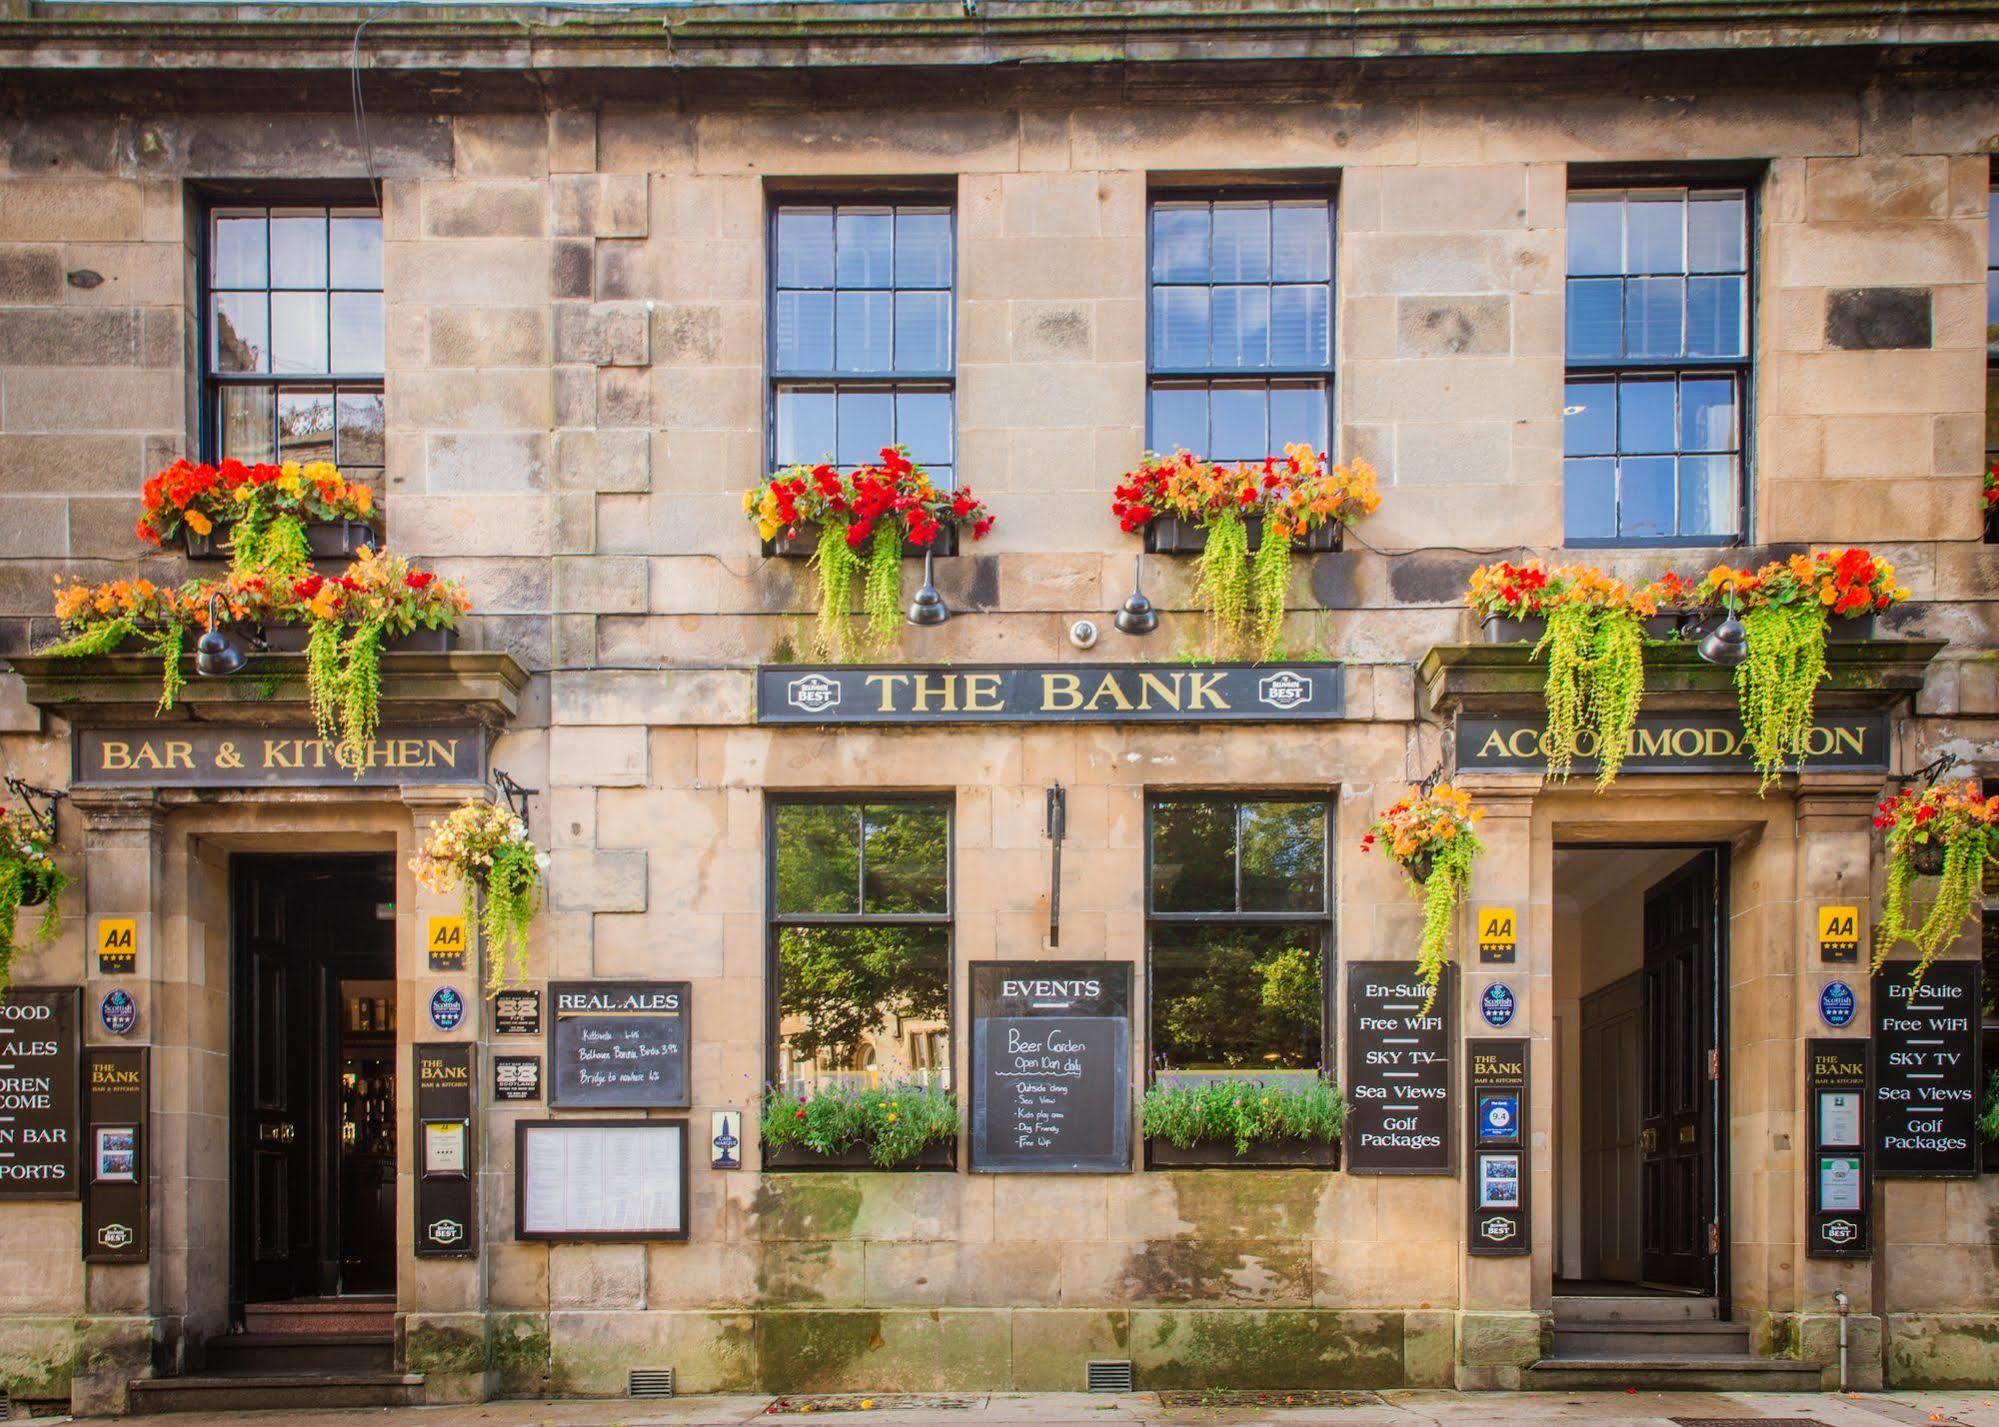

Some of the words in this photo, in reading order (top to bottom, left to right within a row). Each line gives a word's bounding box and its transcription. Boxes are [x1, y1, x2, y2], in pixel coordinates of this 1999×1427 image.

[798, 691, 832, 701] BEST
[865, 673, 1005, 712] THE
[1040, 672, 1231, 711] BANK
[1269, 688, 1303, 698] BEST
[102, 741, 195, 769] BAR
[215, 741, 243, 768] &
[263, 739, 458, 769] KITCHEN
[1485, 918, 1511, 937] AA
[1826, 917, 1853, 936] AA
[104, 929, 132, 947] AA
[433, 926, 460, 945] AA
[1002, 980, 1101, 997] EVENTS
[1889, 985, 1962, 998] En-Suite
[559, 994, 616, 1009] REAL
[623, 994, 679, 1009] ALES
[1360, 1017, 1398, 1030] Free
[1404, 1017, 1442, 1030] WiFi
[1883, 1018, 1922, 1031] Free
[1929, 1018, 1968, 1031] WiFi
[1008, 1028, 1042, 1053] Beer
[2, 1041, 58, 1056] ALES
[1015, 1056, 1039, 1072] Open
[1366, 1051, 1403, 1064] SKY
[1408, 1051, 1436, 1064] TV
[1889, 1052, 1927, 1065] SKY
[1934, 1053, 1961, 1065] TV
[421, 1067, 467, 1078] BANK
[1474, 1063, 1522, 1074] BANK
[1815, 1063, 1863, 1074] BANK
[92, 1071, 140, 1082] BANK
[580, 1068, 606, 1086] Bridge
[608, 1071, 617, 1082] to
[1017, 1082, 1046, 1093] Outside
[1355, 1085, 1386, 1098] Sea
[1394, 1085, 1446, 1099] Views
[1878, 1087, 1910, 1100] Sea
[1918, 1087, 1972, 1100] Views
[1019, 1094, 1033, 1104] Sea
[1018, 1107, 1034, 1118] Kids
[1036, 1110, 1049, 1122] play
[1492, 1112, 1506, 1120] 9.4
[1019, 1122, 1032, 1134] Dog
[1383, 1117, 1418, 1131] Golf
[1907, 1120, 1943, 1133] Golf
[23, 1128, 67, 1143] BAR
[1019, 1135, 1034, 1148] Free
[1361, 1134, 1440, 1149] Packages
[1885, 1136, 1966, 1151] Packages
